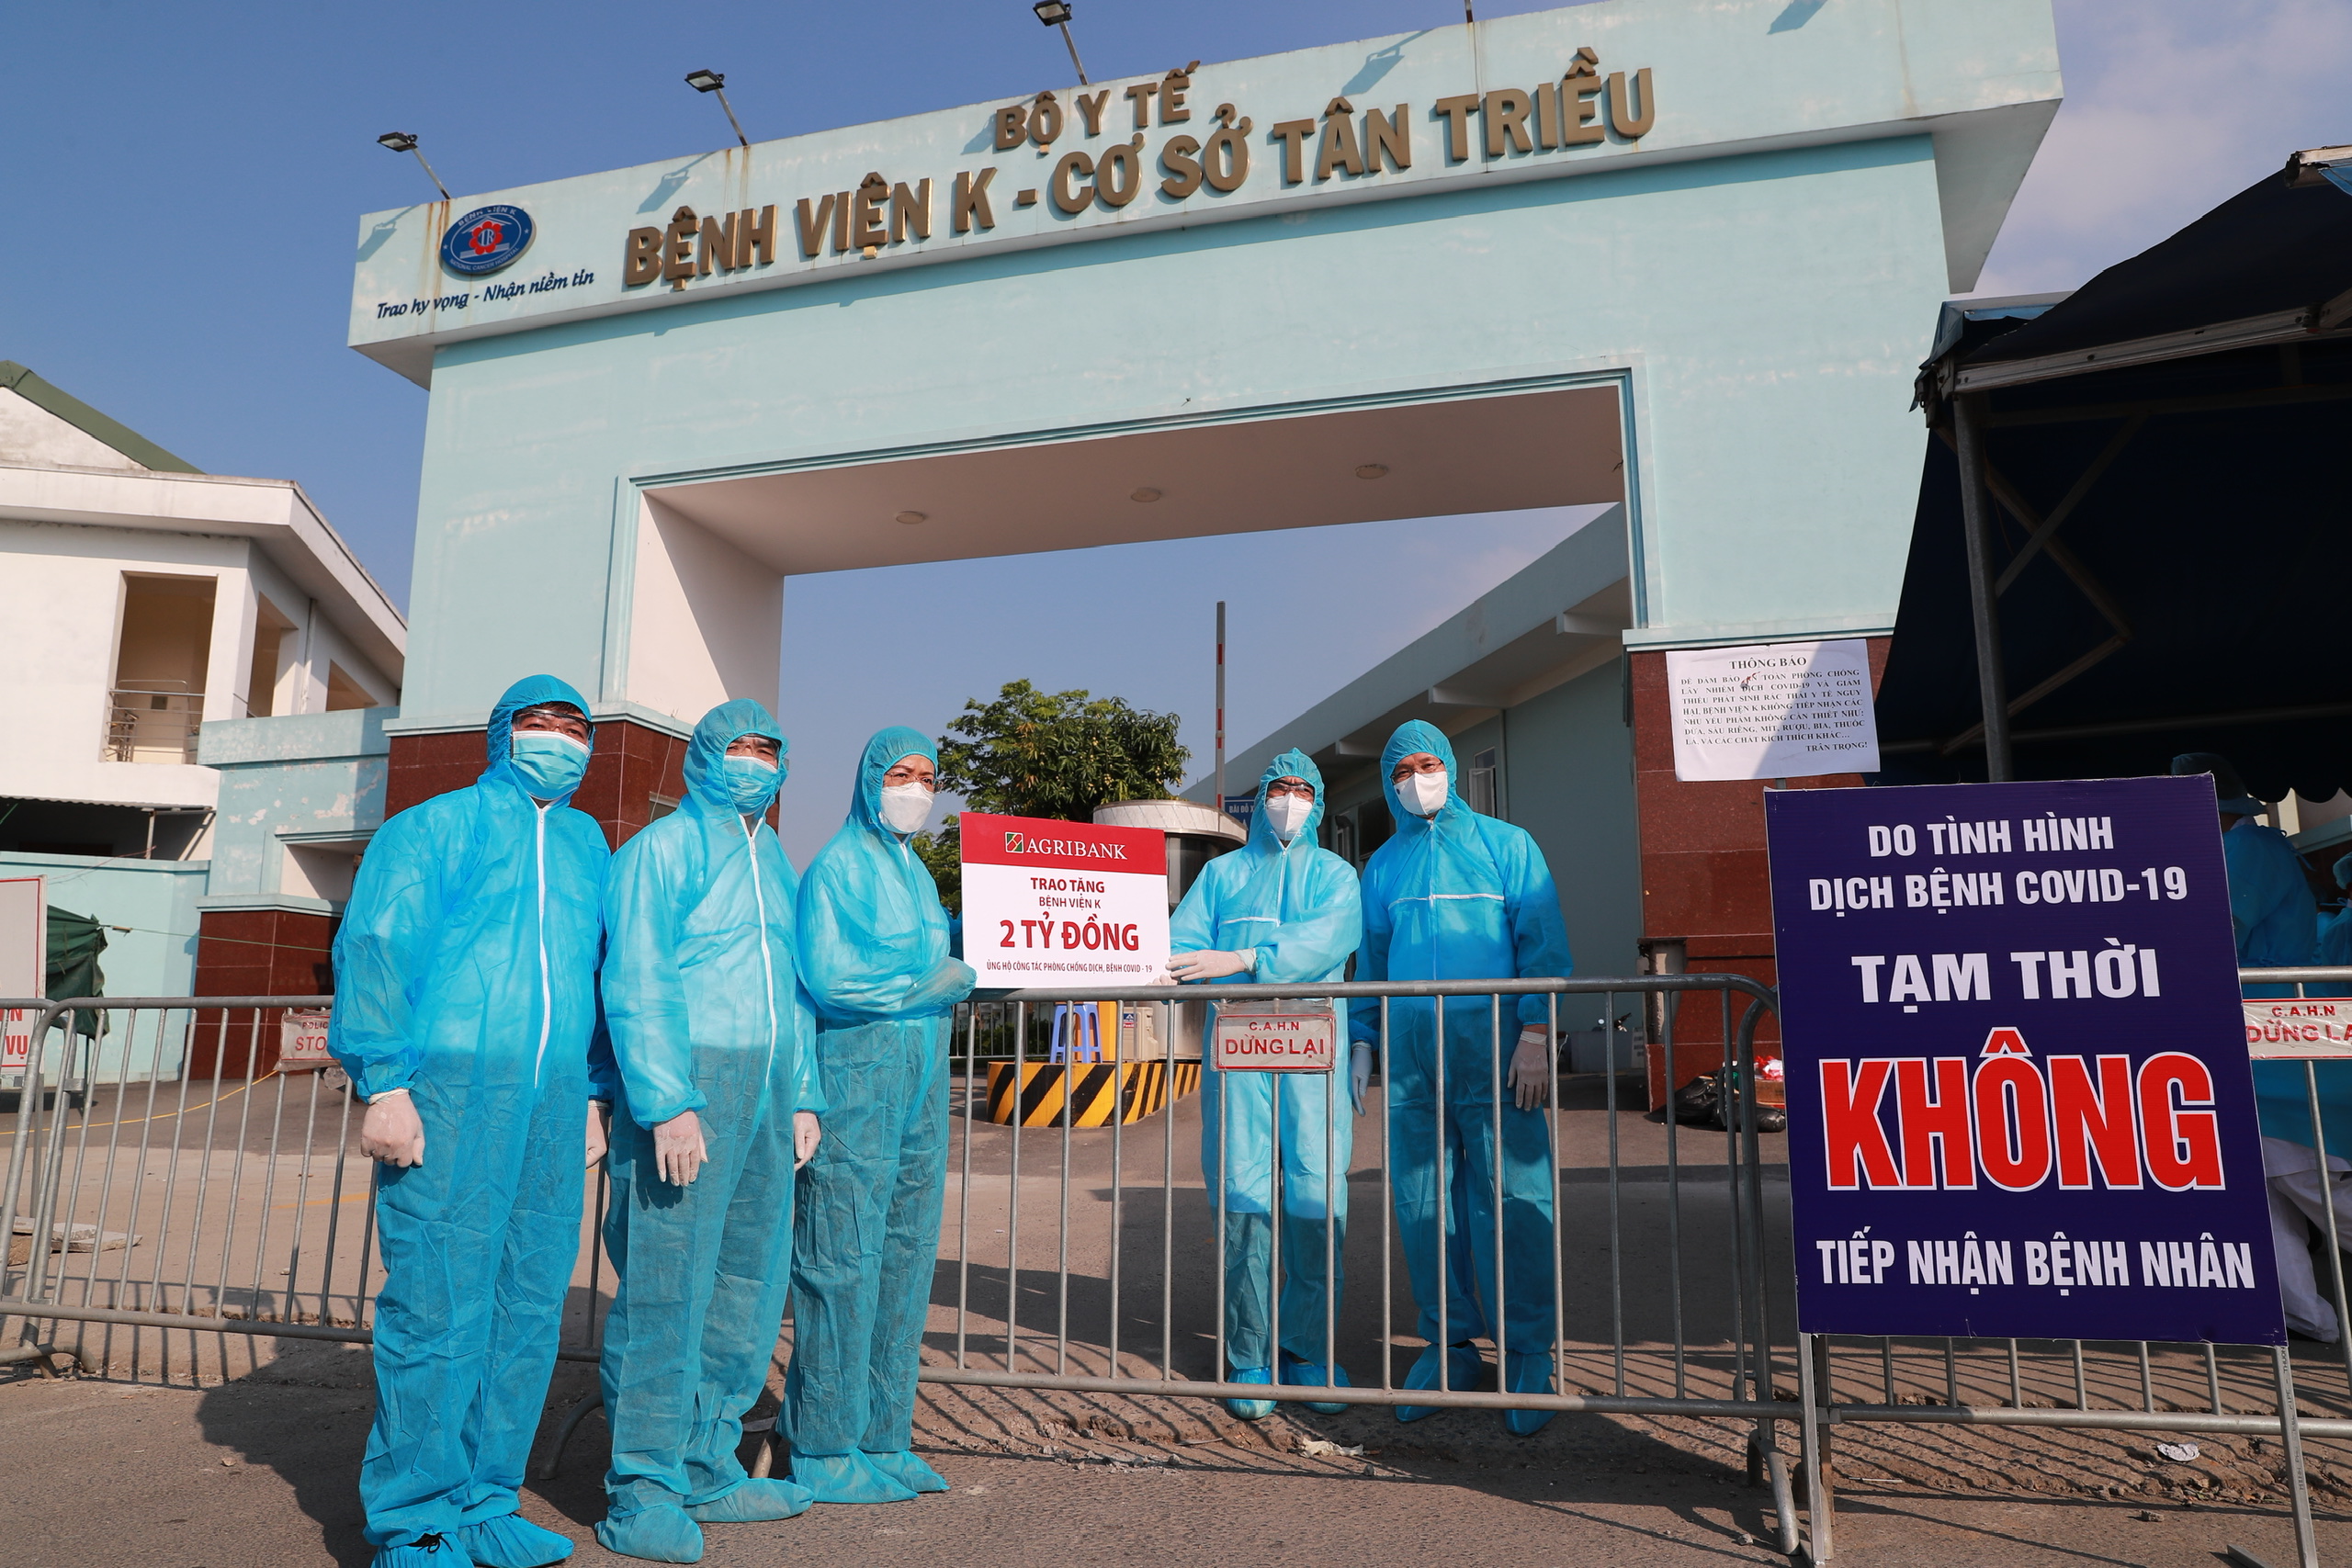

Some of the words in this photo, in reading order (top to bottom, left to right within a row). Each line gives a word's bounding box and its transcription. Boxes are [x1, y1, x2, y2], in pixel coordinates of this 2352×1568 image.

[994, 91, 1064, 154] BỘ
[1077, 90, 1111, 136] Y
[1126, 60, 1201, 129] TẾ
[625, 205, 778, 291] BỆNH
[796, 171, 933, 259] VIỆN
[955, 167, 998, 231] K
[1052, 132, 1147, 214] CƠ
[1161, 103, 1253, 198] SỞ
[1273, 96, 1412, 184] TÂN
[1437, 47, 1656, 163] TRIỀU
[377, 302, 408, 319] Trao
[411, 298, 430, 315] hy
[434, 293, 469, 312] vọng
[483, 282, 526, 302] Nhận
[528, 272, 569, 294] niềm
[1729, 658, 1776, 671] THÔNG
[1780, 655, 1807, 668] BÁO
[1770, 682, 1810, 691] COVID-19
[1837, 689, 1861, 697] NGUY
[1760, 702, 1792, 711] KHÔNG
[1684, 717, 1702, 726] NHU
[1755, 714, 1787, 722] KHÔNG
[1868, 823, 1917, 857] DO
[1927, 815, 2012, 854] TÌNH
[2023, 811, 2114, 852] HÌNH
[1026, 838, 1127, 860] AGRIBANK
[1030, 877, 1067, 891] TRAO
[1069, 877, 1105, 896] TẶNG
[1809, 878, 1894, 917] DỊCH
[1906, 867, 2004, 914] BỆNH
[2016, 866, 2188, 905] COVID-19
[1039, 895, 1067, 909] BỆNH
[1069, 896, 1091, 911] VIỆN
[1094, 898, 1102, 908] K
[1000, 919, 1015, 948] 2
[1021, 911, 1055, 949] TỶ
[1061, 913, 1139, 951] ĐỒNG
[1002, 960, 1012, 973] HỘ
[1012, 961, 1030, 971] CÔNG
[1032, 961, 1043, 971] TÁC
[1044, 962, 1066, 972] PHÒNG
[1066, 961, 1088, 972] CHỐNG
[1105, 963, 1123, 975] BỆNH
[1123, 964, 1141, 973] COVID
[1146, 964, 1153, 973] 19
[1851, 953, 1991, 1013] TẠM
[2010, 937, 2161, 1000] THỜI
[2272, 1006, 2335, 1017] C.A.H.N
[302, 1021, 329, 1030] POLIC
[1249, 1021, 1300, 1031] C.A.H.N
[2245, 1019, 2320, 1043] DỪNG
[295, 1035, 328, 1051] STO
[1225, 1033, 1284, 1055] DỪNG
[1289, 1038, 1324, 1058] LẠI
[1819, 1026, 2226, 1192] KHÔNG
[1816, 1226, 1895, 1284] TIẾP
[1907, 1231, 2014, 1295] NHẬN
[2026, 1231, 2130, 1296] BỆNH
[2142, 1232, 2255, 1290] NHÂN
